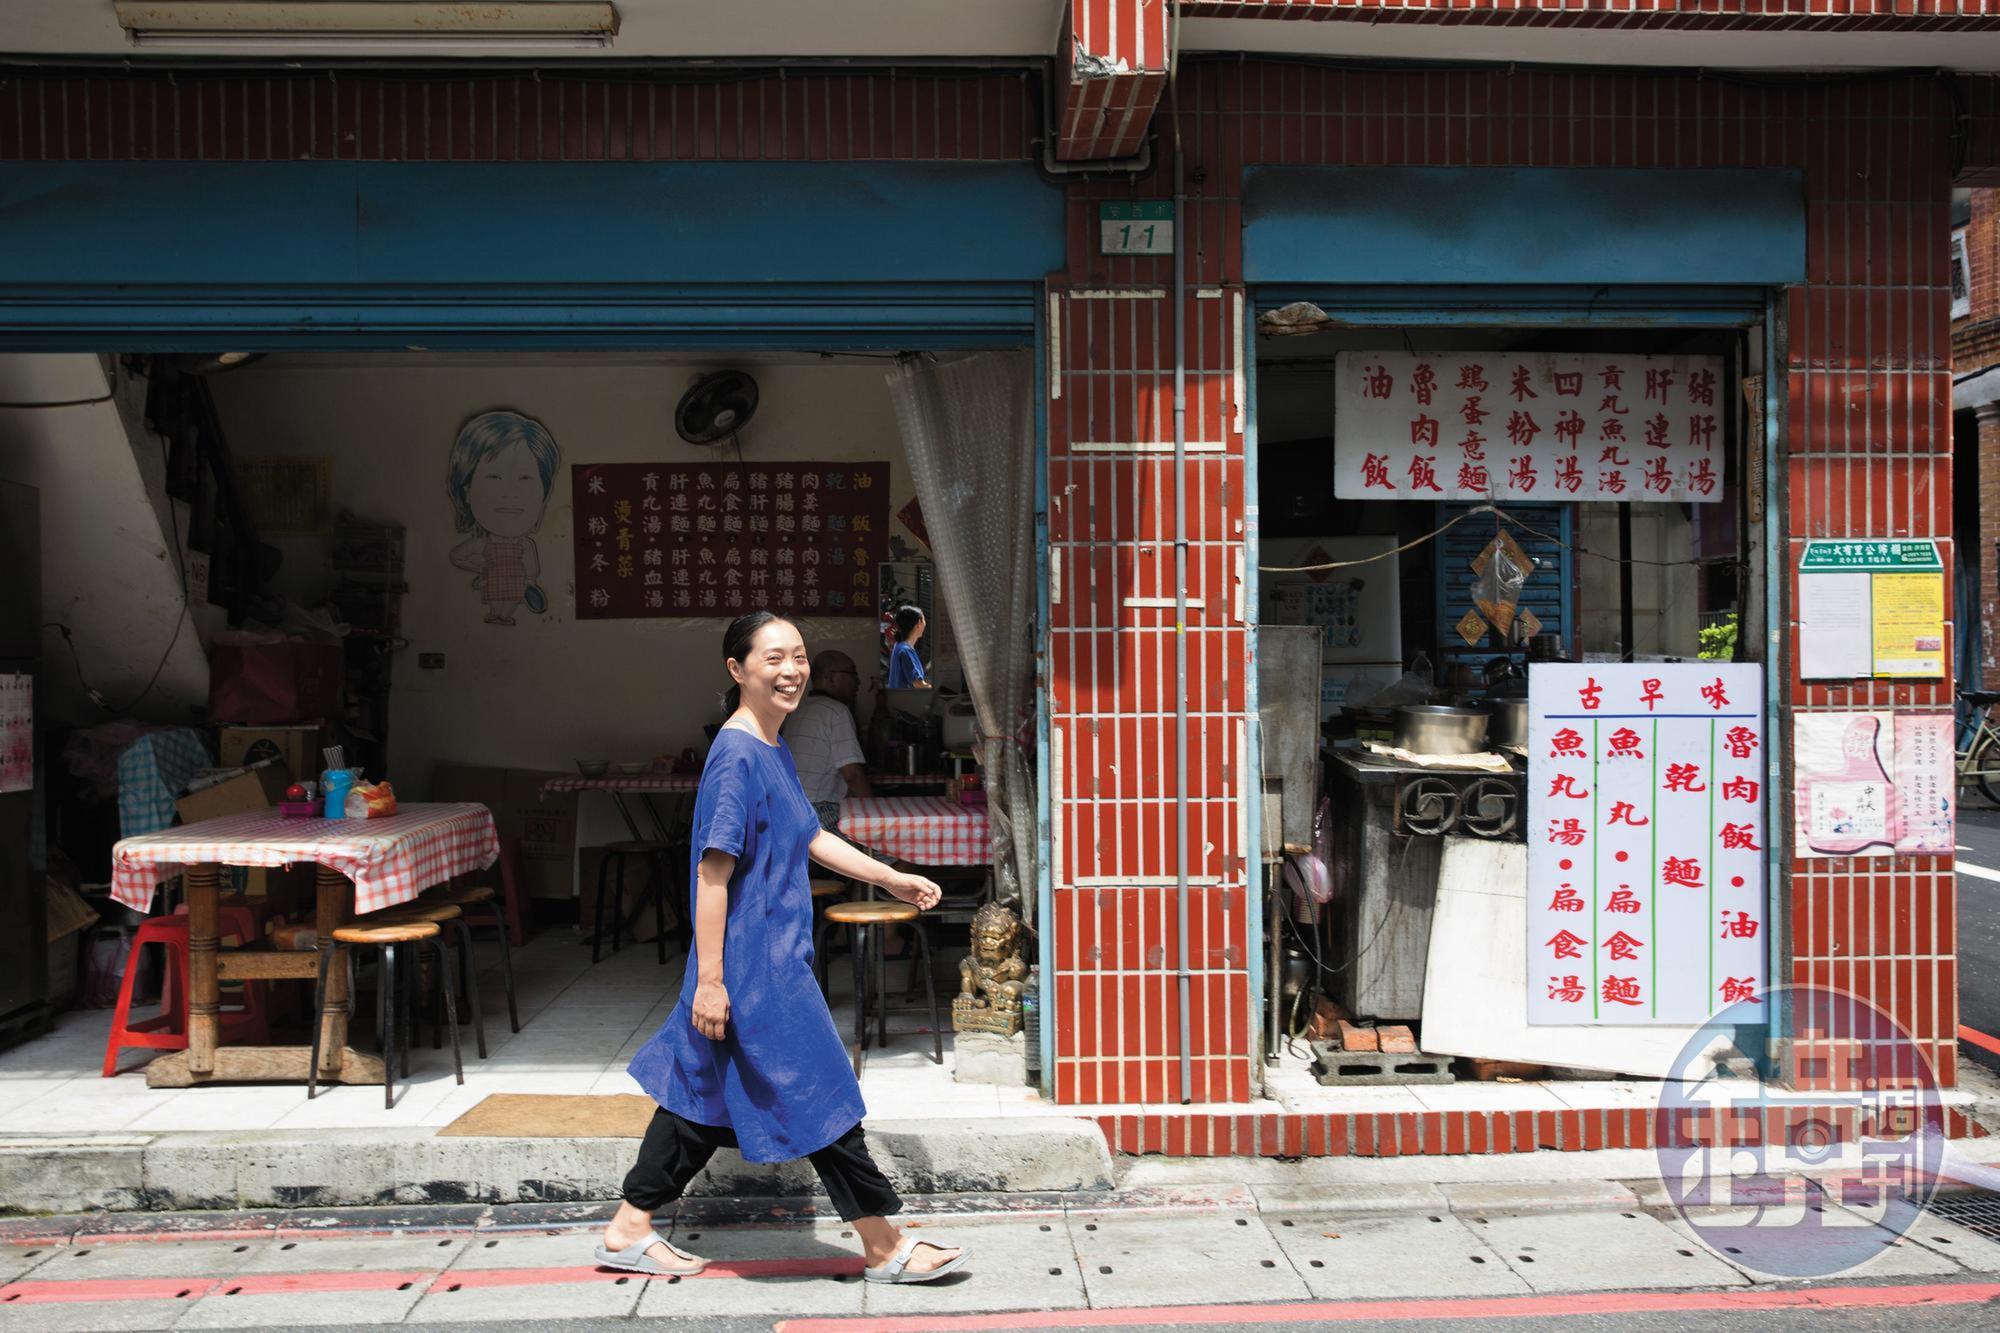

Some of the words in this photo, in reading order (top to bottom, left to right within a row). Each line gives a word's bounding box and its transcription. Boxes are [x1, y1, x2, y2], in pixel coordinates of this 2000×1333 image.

[1120, 224, 1155, 249] 11
[1360, 366, 1397, 491] 油飯
[1407, 364, 1443, 493] 魯肉飯
[1507, 364, 1542, 493] 米粉湯
[1553, 367, 1586, 493] 四神湯
[1598, 365, 1630, 494] 貢丸魚丸湯
[1644, 369, 1674, 495] 肝連湯
[1687, 368, 1718, 496] 豬肝湯
[1578, 677, 1730, 711] 古早味
[1662, 762, 1706, 889] 乾麵
